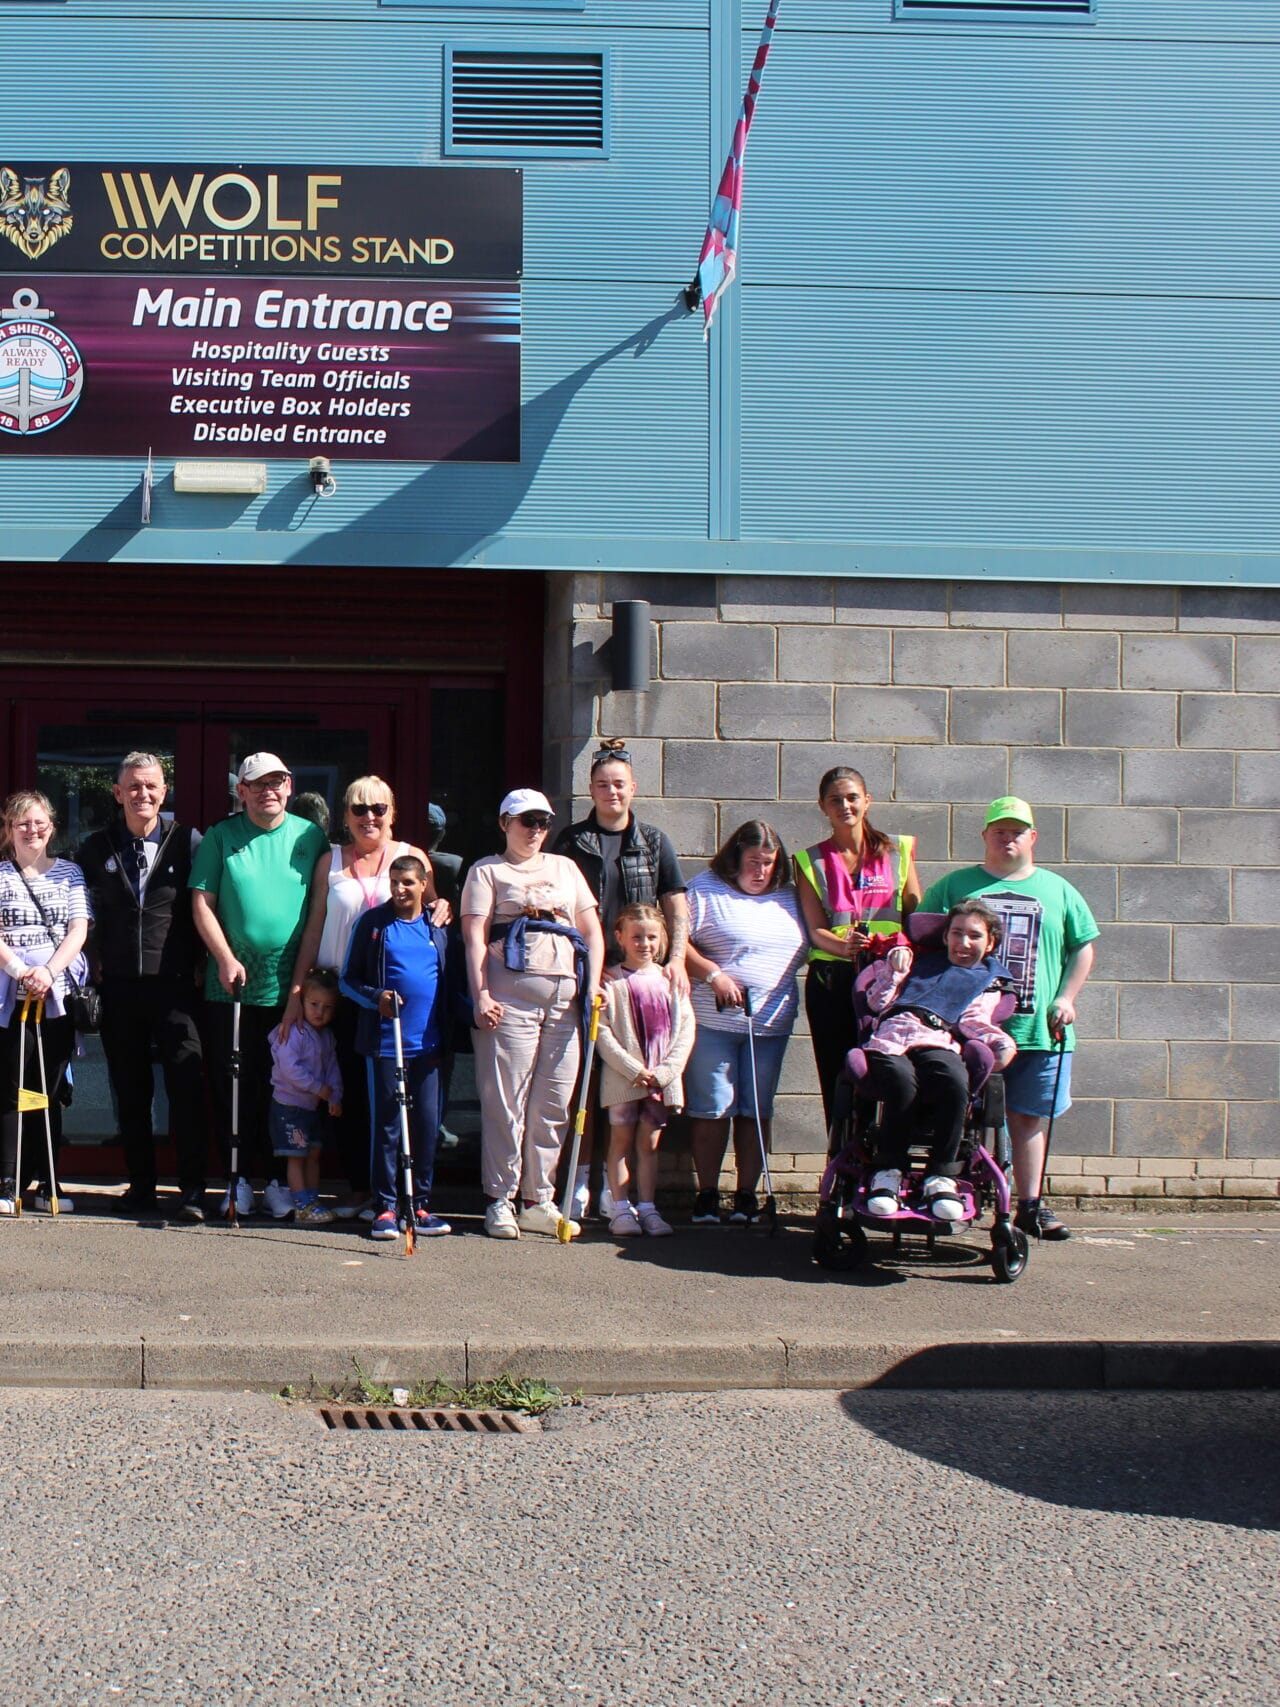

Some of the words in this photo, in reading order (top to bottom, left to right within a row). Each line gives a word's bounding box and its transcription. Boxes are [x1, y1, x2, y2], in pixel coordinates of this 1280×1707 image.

[139, 173, 342, 231] WOLF
[100, 233, 342, 263] COMPETITIONS
[351, 236, 455, 265] STAND
[132, 288, 242, 328] Main
[254, 290, 453, 332] Entrance
[2, 348, 47, 357] ALWAYS
[8, 323, 62, 346] SHIELDS
[59, 346, 76, 369] F.C.
[191, 341, 312, 364] Hospitality
[317, 343, 390, 362] Guests
[6, 357, 45, 367] READY
[171, 368, 253, 391] Visiting
[261, 369, 316, 388] Team
[322, 370, 411, 392] Officials
[170, 395, 275, 415] Executive
[282, 397, 322, 416] Box
[328, 398, 411, 417] Holders
[0, 415, 13, 427] 18
[34, 415, 51, 427] 88
[193, 423, 287, 443] Disabled
[292, 425, 387, 444] Entrance
